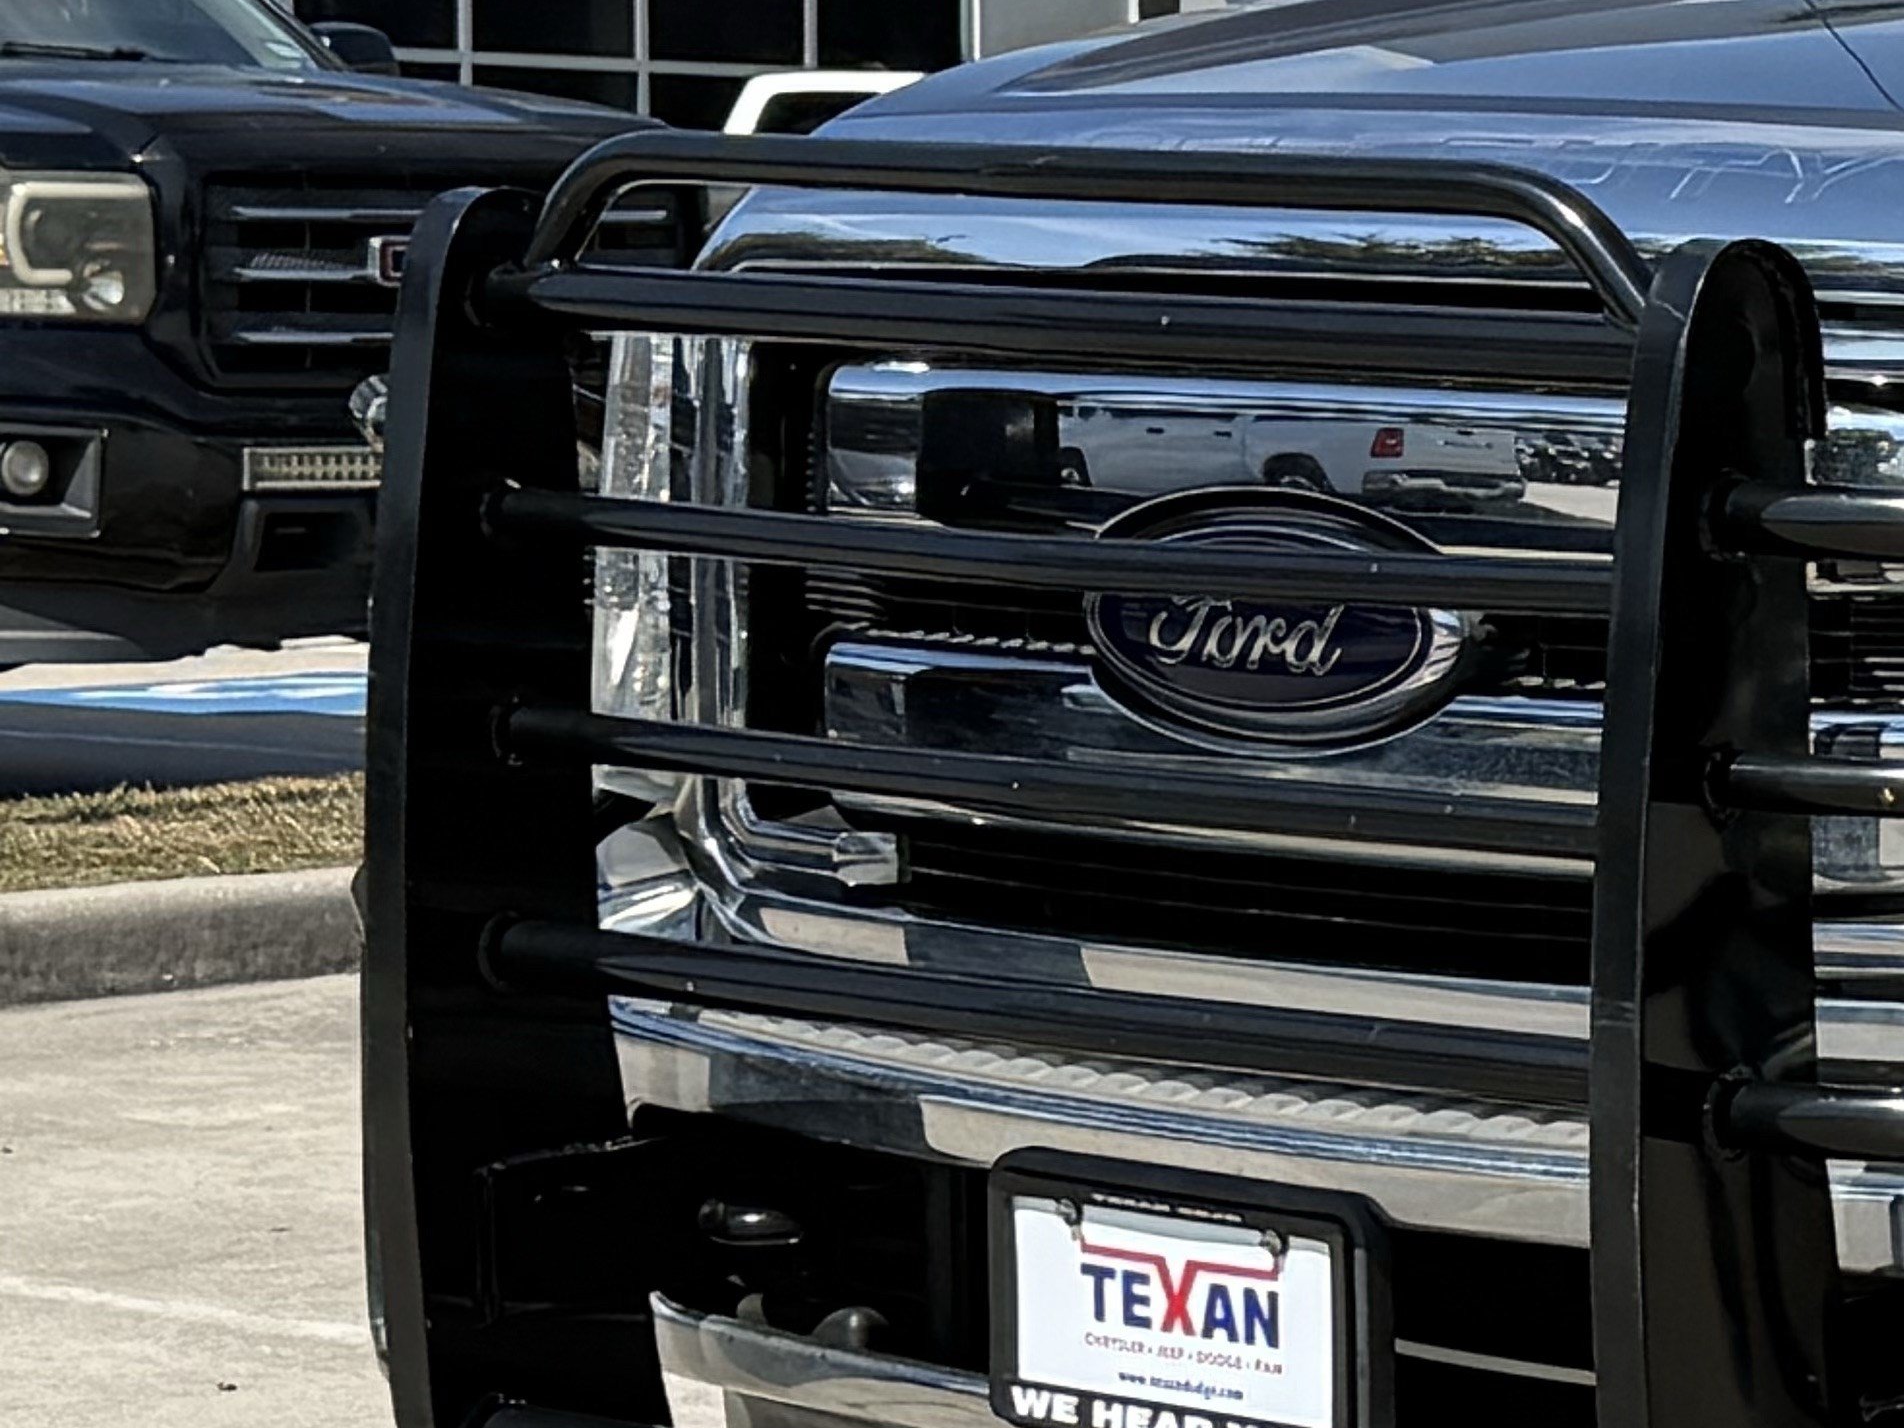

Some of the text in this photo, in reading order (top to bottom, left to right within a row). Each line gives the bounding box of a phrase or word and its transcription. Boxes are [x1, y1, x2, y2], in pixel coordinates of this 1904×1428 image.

[1149, 594, 1345, 677] Ford
[1079, 1242, 1280, 1350] TEXAN
[1010, 1385, 1079, 1424] WE
